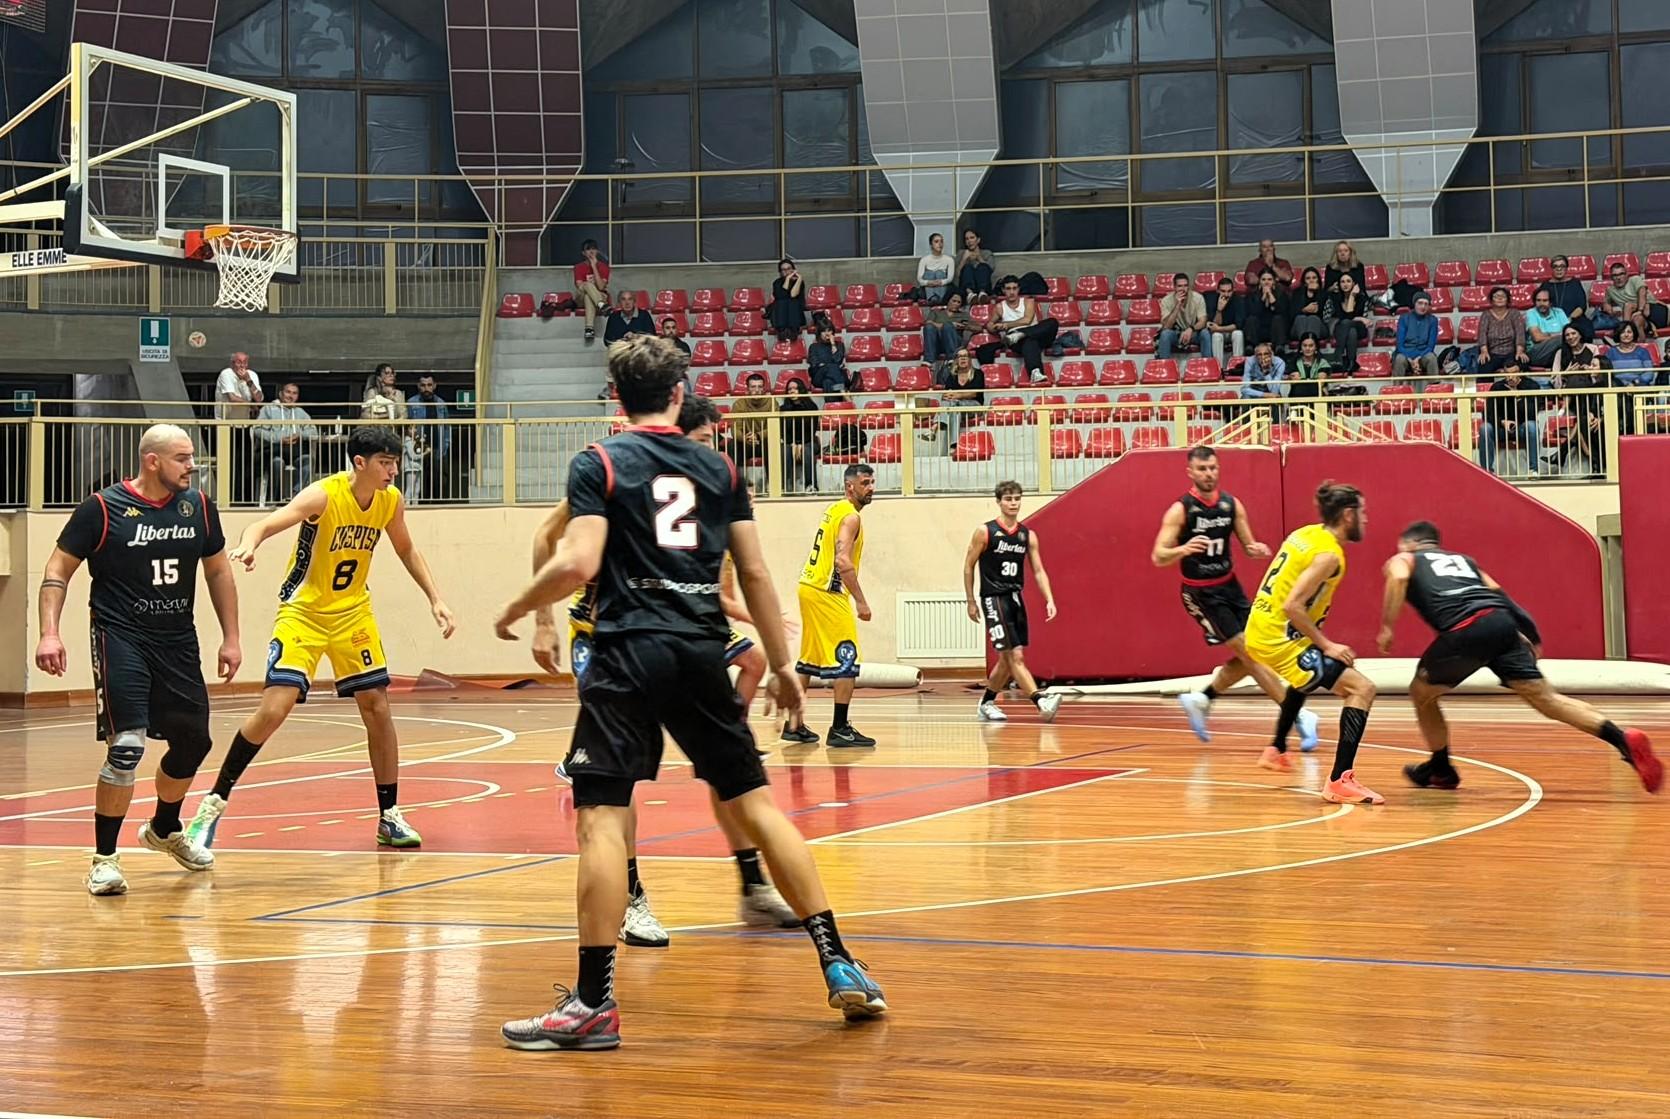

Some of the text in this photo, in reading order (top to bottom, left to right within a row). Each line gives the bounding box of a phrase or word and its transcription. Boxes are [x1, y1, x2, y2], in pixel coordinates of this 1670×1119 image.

[12, 250, 67, 268] ELLE EMME
[650, 474, 699, 549] 2
[127, 524, 196, 547] Libertas
[809, 528, 824, 566] 5
[151, 558, 179, 586] 15
[332, 559, 358, 591] 8
[1001, 561, 1018, 577] 30
[1261, 552, 1287, 595] 2
[361, 649, 372, 666] 8
